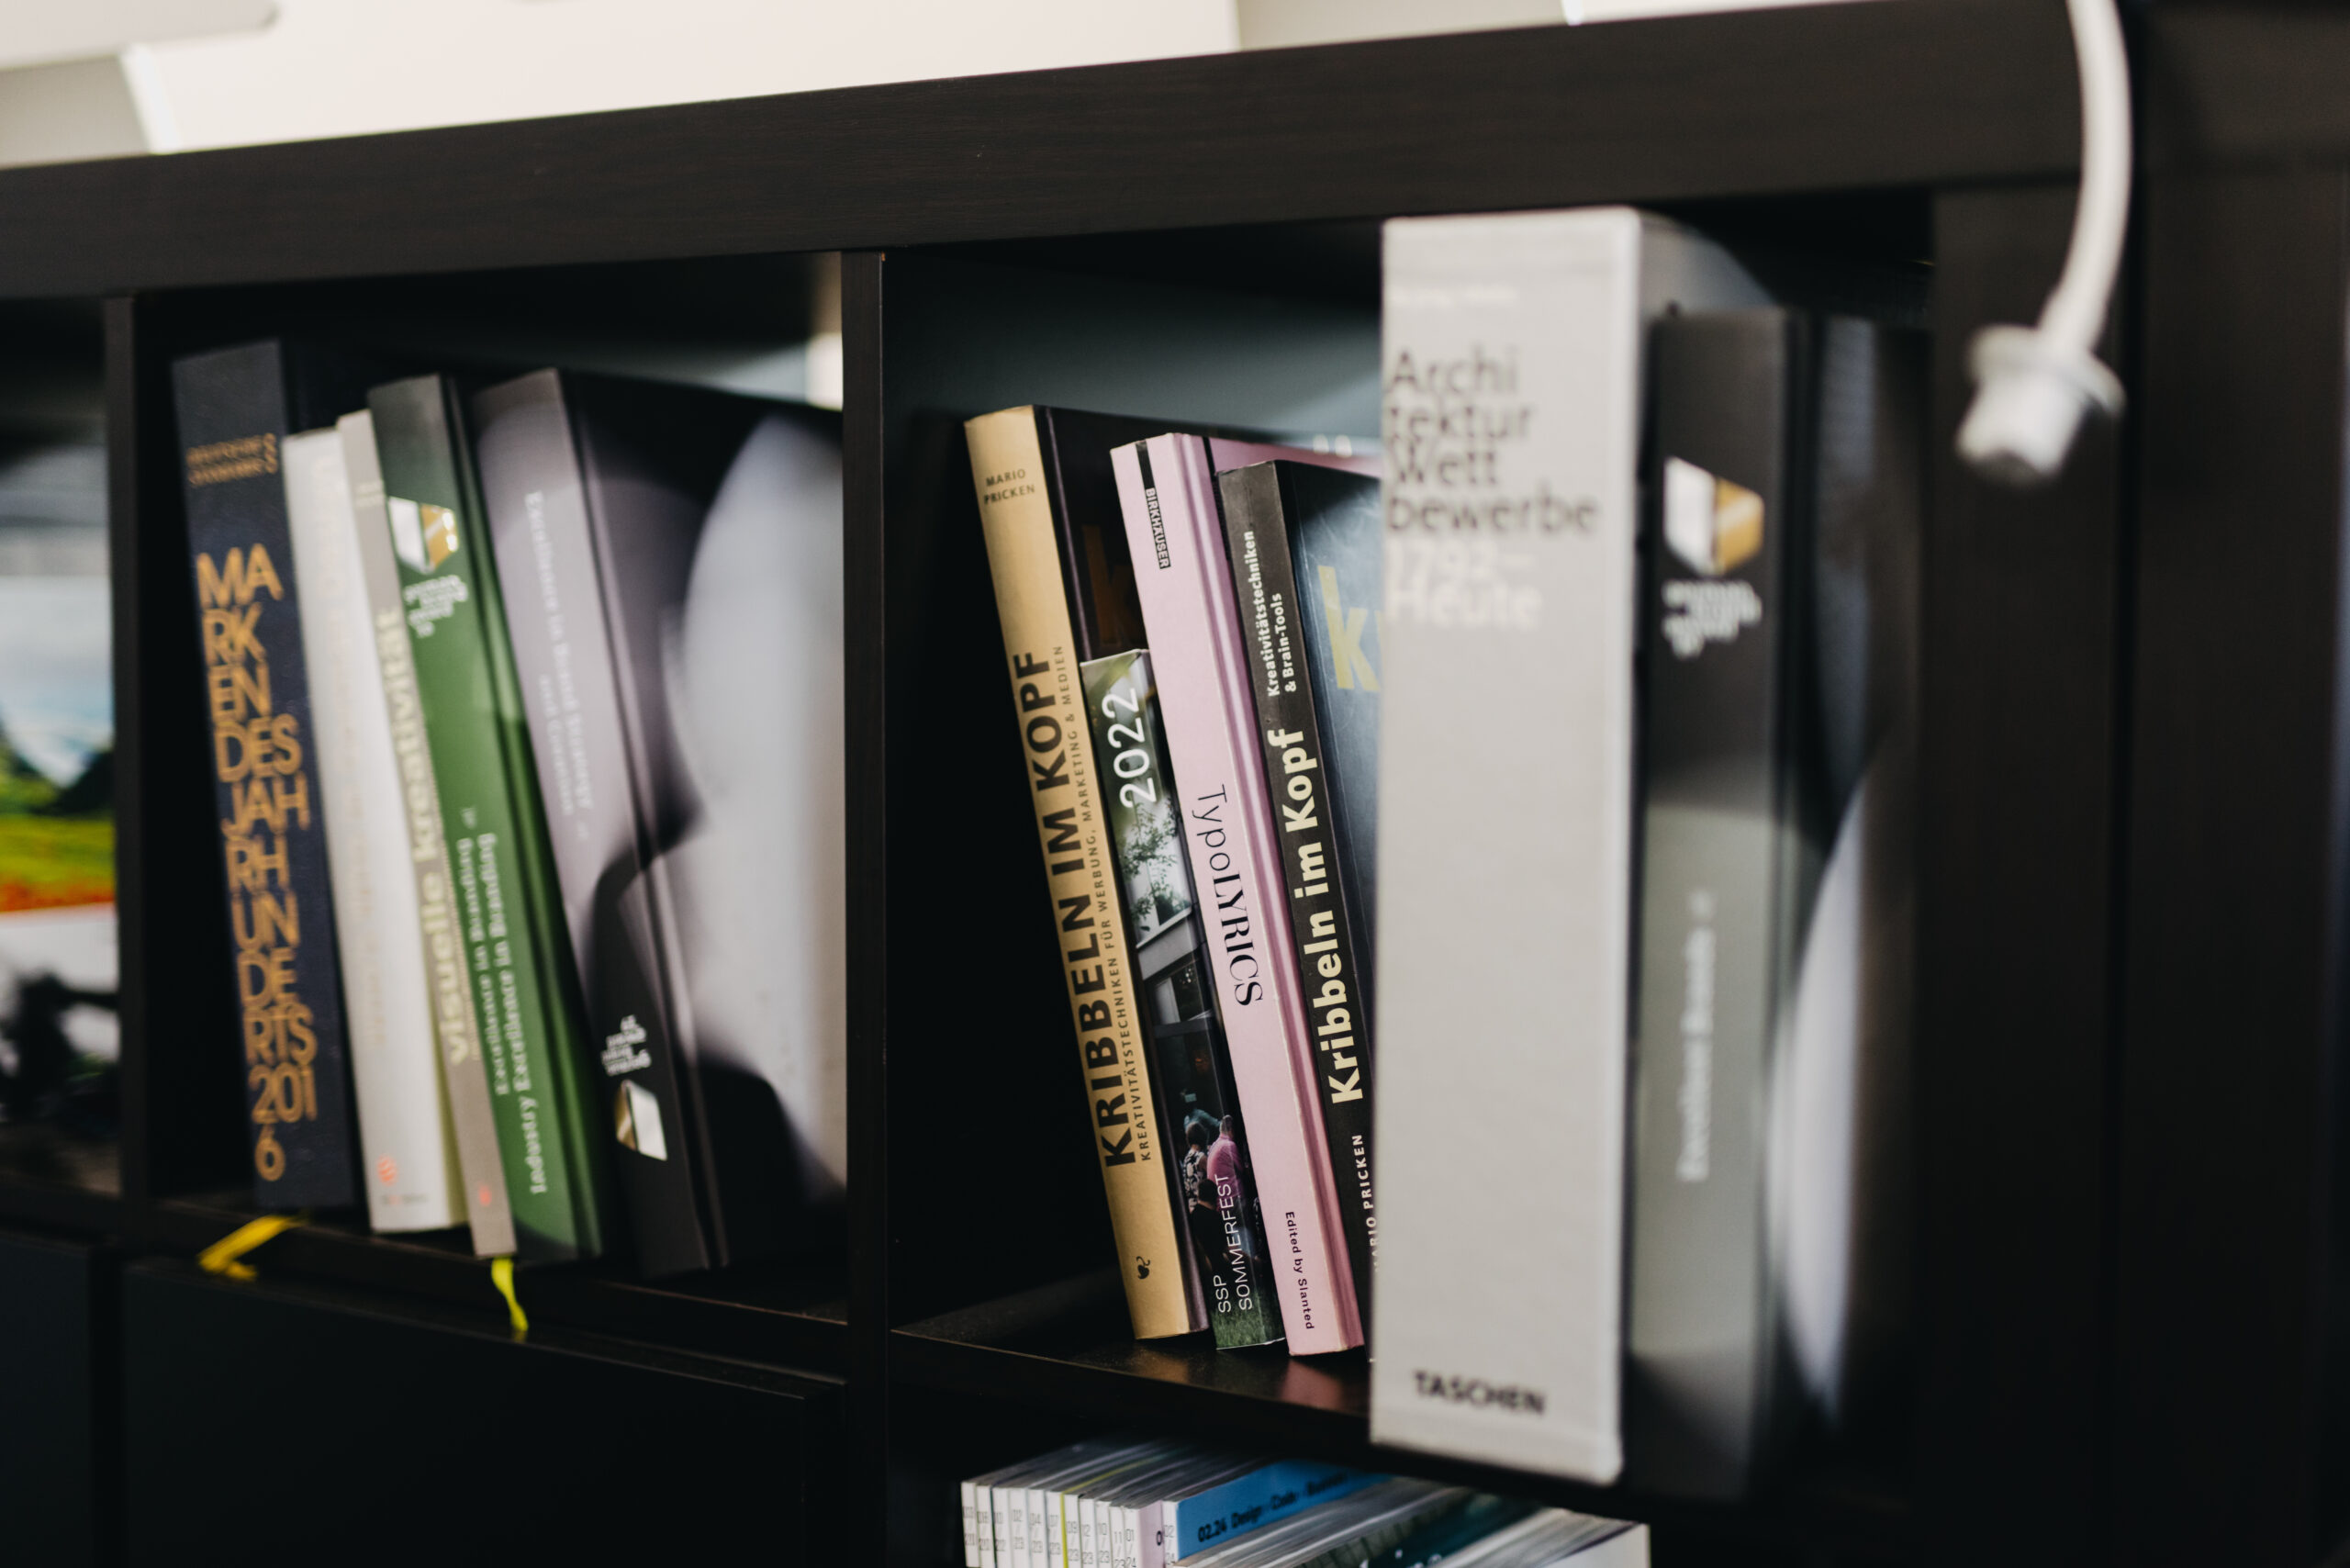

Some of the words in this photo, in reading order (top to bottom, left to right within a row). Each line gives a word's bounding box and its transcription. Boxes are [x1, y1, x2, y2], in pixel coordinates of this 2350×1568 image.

[1389, 342, 1521, 395] Archi
[1386, 395, 1532, 441] tektur
[985, 468, 1026, 487] MARIO
[1387, 435, 1498, 487] Wett
[983, 484, 1035, 505] PRICKEN
[1386, 482, 1599, 534] bewerbe
[1145, 487, 1170, 569] BIRKHÄUSER
[196, 543, 285, 610] MA
[201, 602, 267, 666] RK
[1244, 530, 1280, 697] Kreativitätstechniken
[1270, 592, 1296, 678] Brain-Tools
[207, 659, 273, 723] EN
[1053, 645, 1073, 706] MEDIEN
[1284, 679, 1297, 693] &
[213, 713, 304, 782] DES
[376, 608, 438, 862] kreativität
[1013, 652, 1070, 792] KOPF
[1065, 712, 1076, 722] &
[1101, 688, 1157, 809] 2022
[220, 771, 311, 839] JAH
[1069, 730, 1094, 823] MARKETING
[1267, 728, 1318, 832] Kopf
[225, 830, 290, 893] RH
[1042, 807, 1085, 876] IM
[1294, 842, 1329, 899] im
[232, 889, 300, 951] UN
[1192, 783, 1263, 1006] TypoLYRICS
[1101, 919, 1115, 950] FÜR
[236, 947, 300, 1010] DE
[420, 871, 471, 1066] visuelle
[1058, 894, 1136, 1168] KRIBBELN
[1304, 910, 1363, 1103] Kribbeln
[1108, 957, 1151, 1161] KREATIVITÄTSTECHNIKEN
[248, 1062, 318, 1124] 201
[254, 1122, 286, 1182] 6
[1351, 1135, 1375, 1210] PRICKEN
[1214, 1173, 1253, 1311] SOMMERFEST
[1285, 1211, 1302, 1254] Edited
[1214, 1274, 1231, 1313] SSP
[1293, 1258, 1304, 1274] by
[1297, 1278, 1315, 1330] Slanted
[1414, 1368, 1546, 1416] TASCHEN
[1197, 1518, 1228, 1543] 02.24
